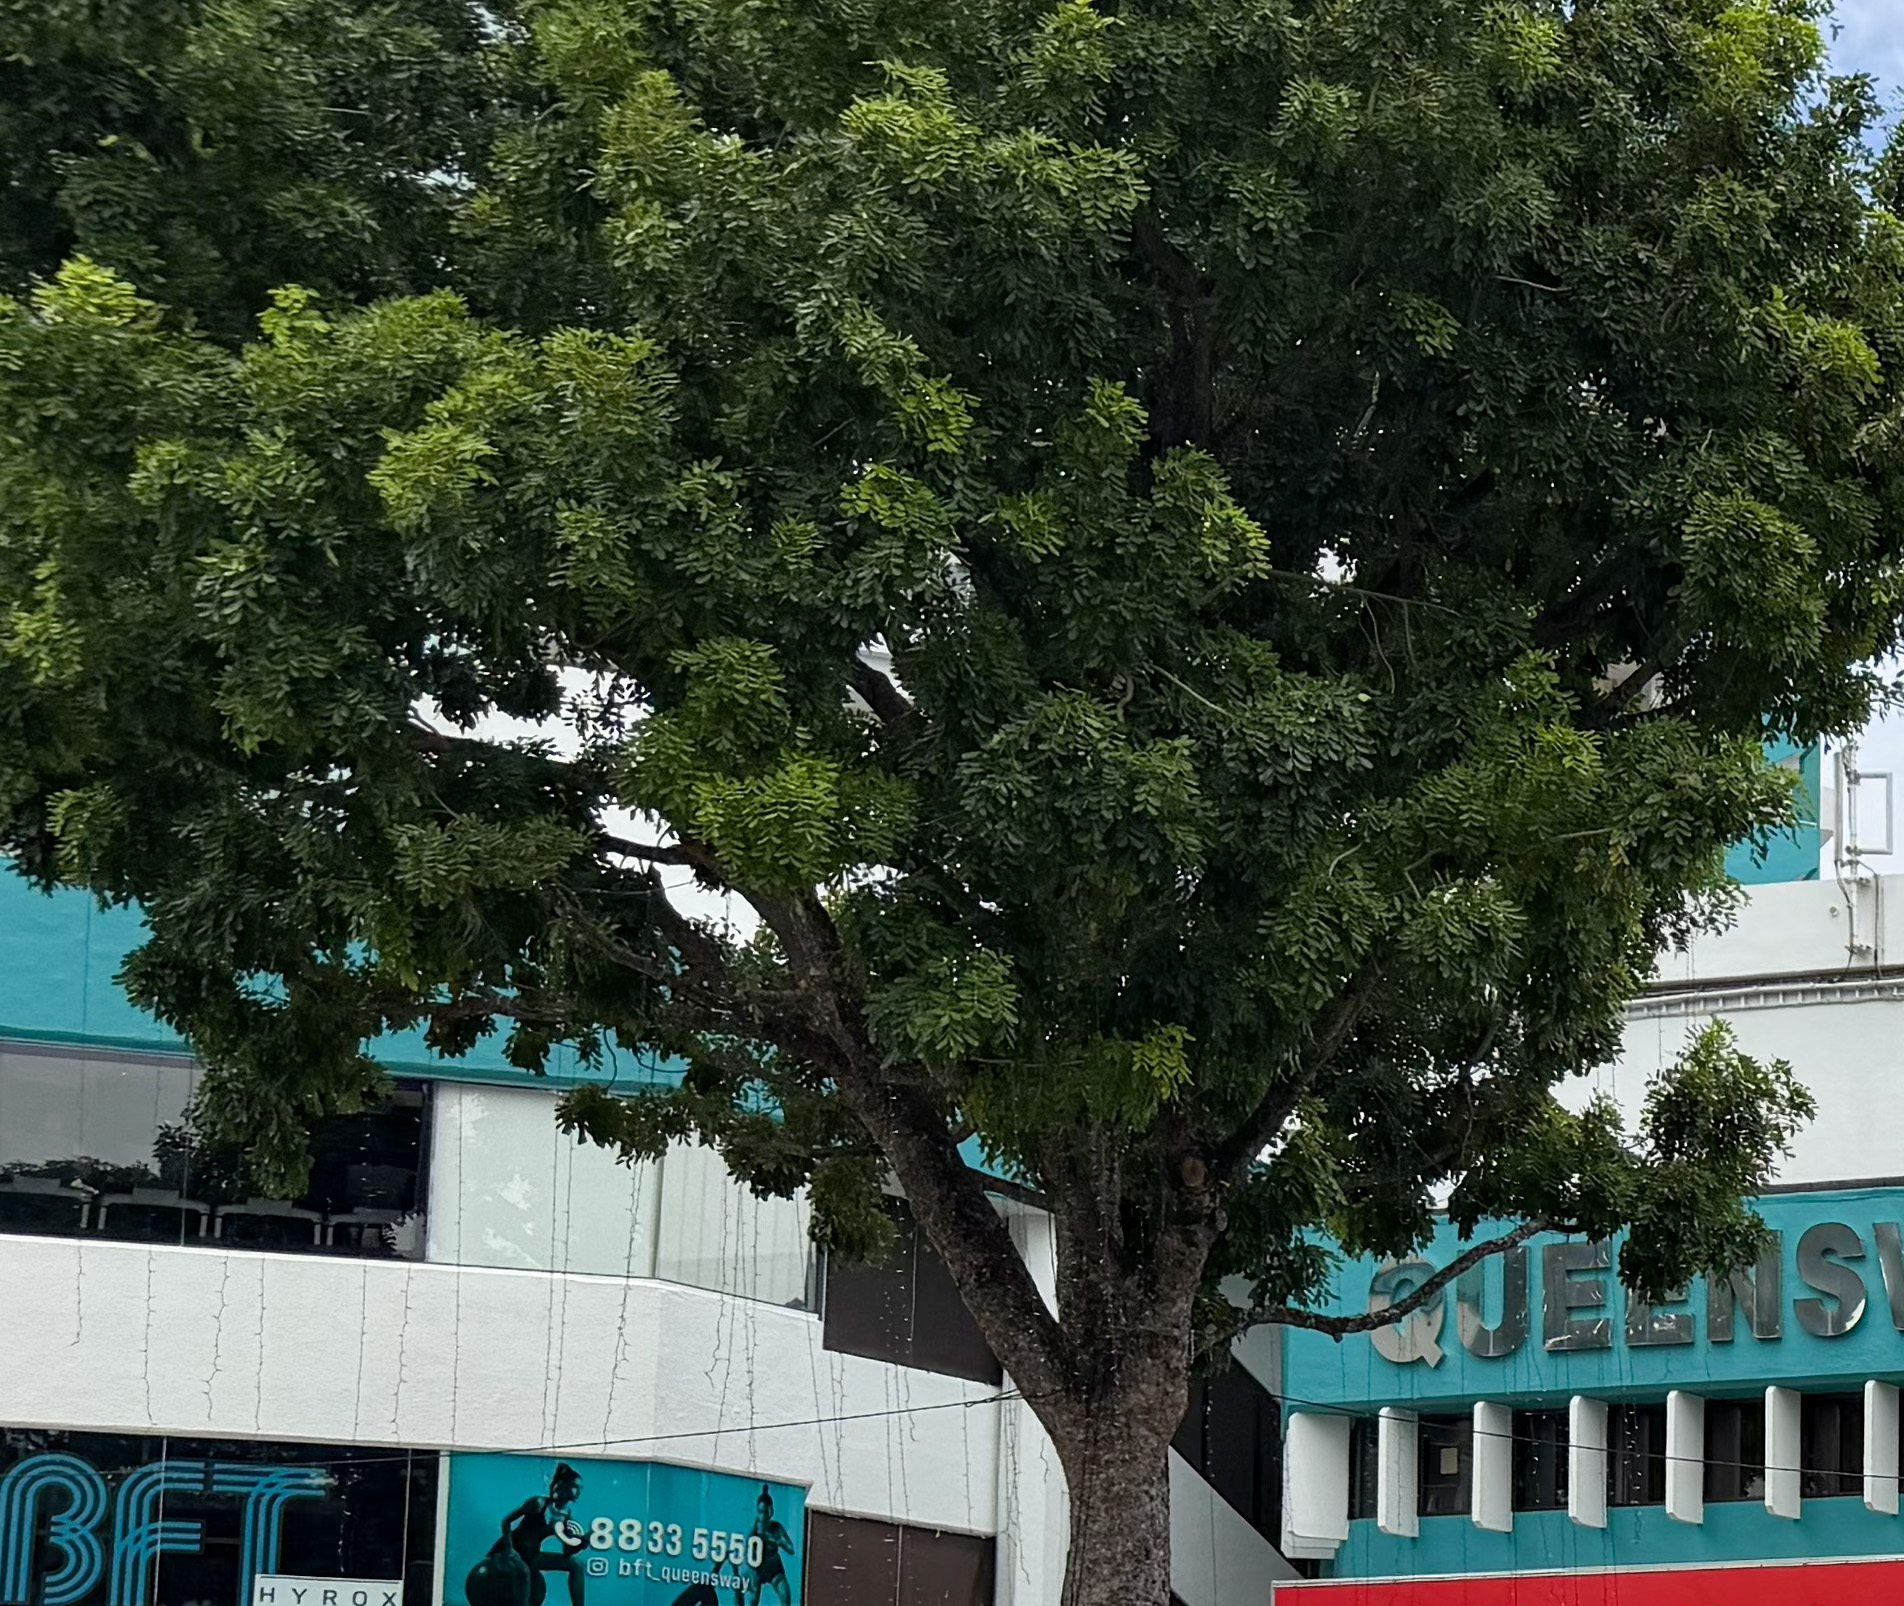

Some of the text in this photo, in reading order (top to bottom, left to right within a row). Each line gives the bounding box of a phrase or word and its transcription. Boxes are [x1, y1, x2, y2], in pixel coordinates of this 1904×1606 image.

[589, 1517, 764, 1568] 8833 5550
[618, 1558, 750, 1593] bft_queensway
